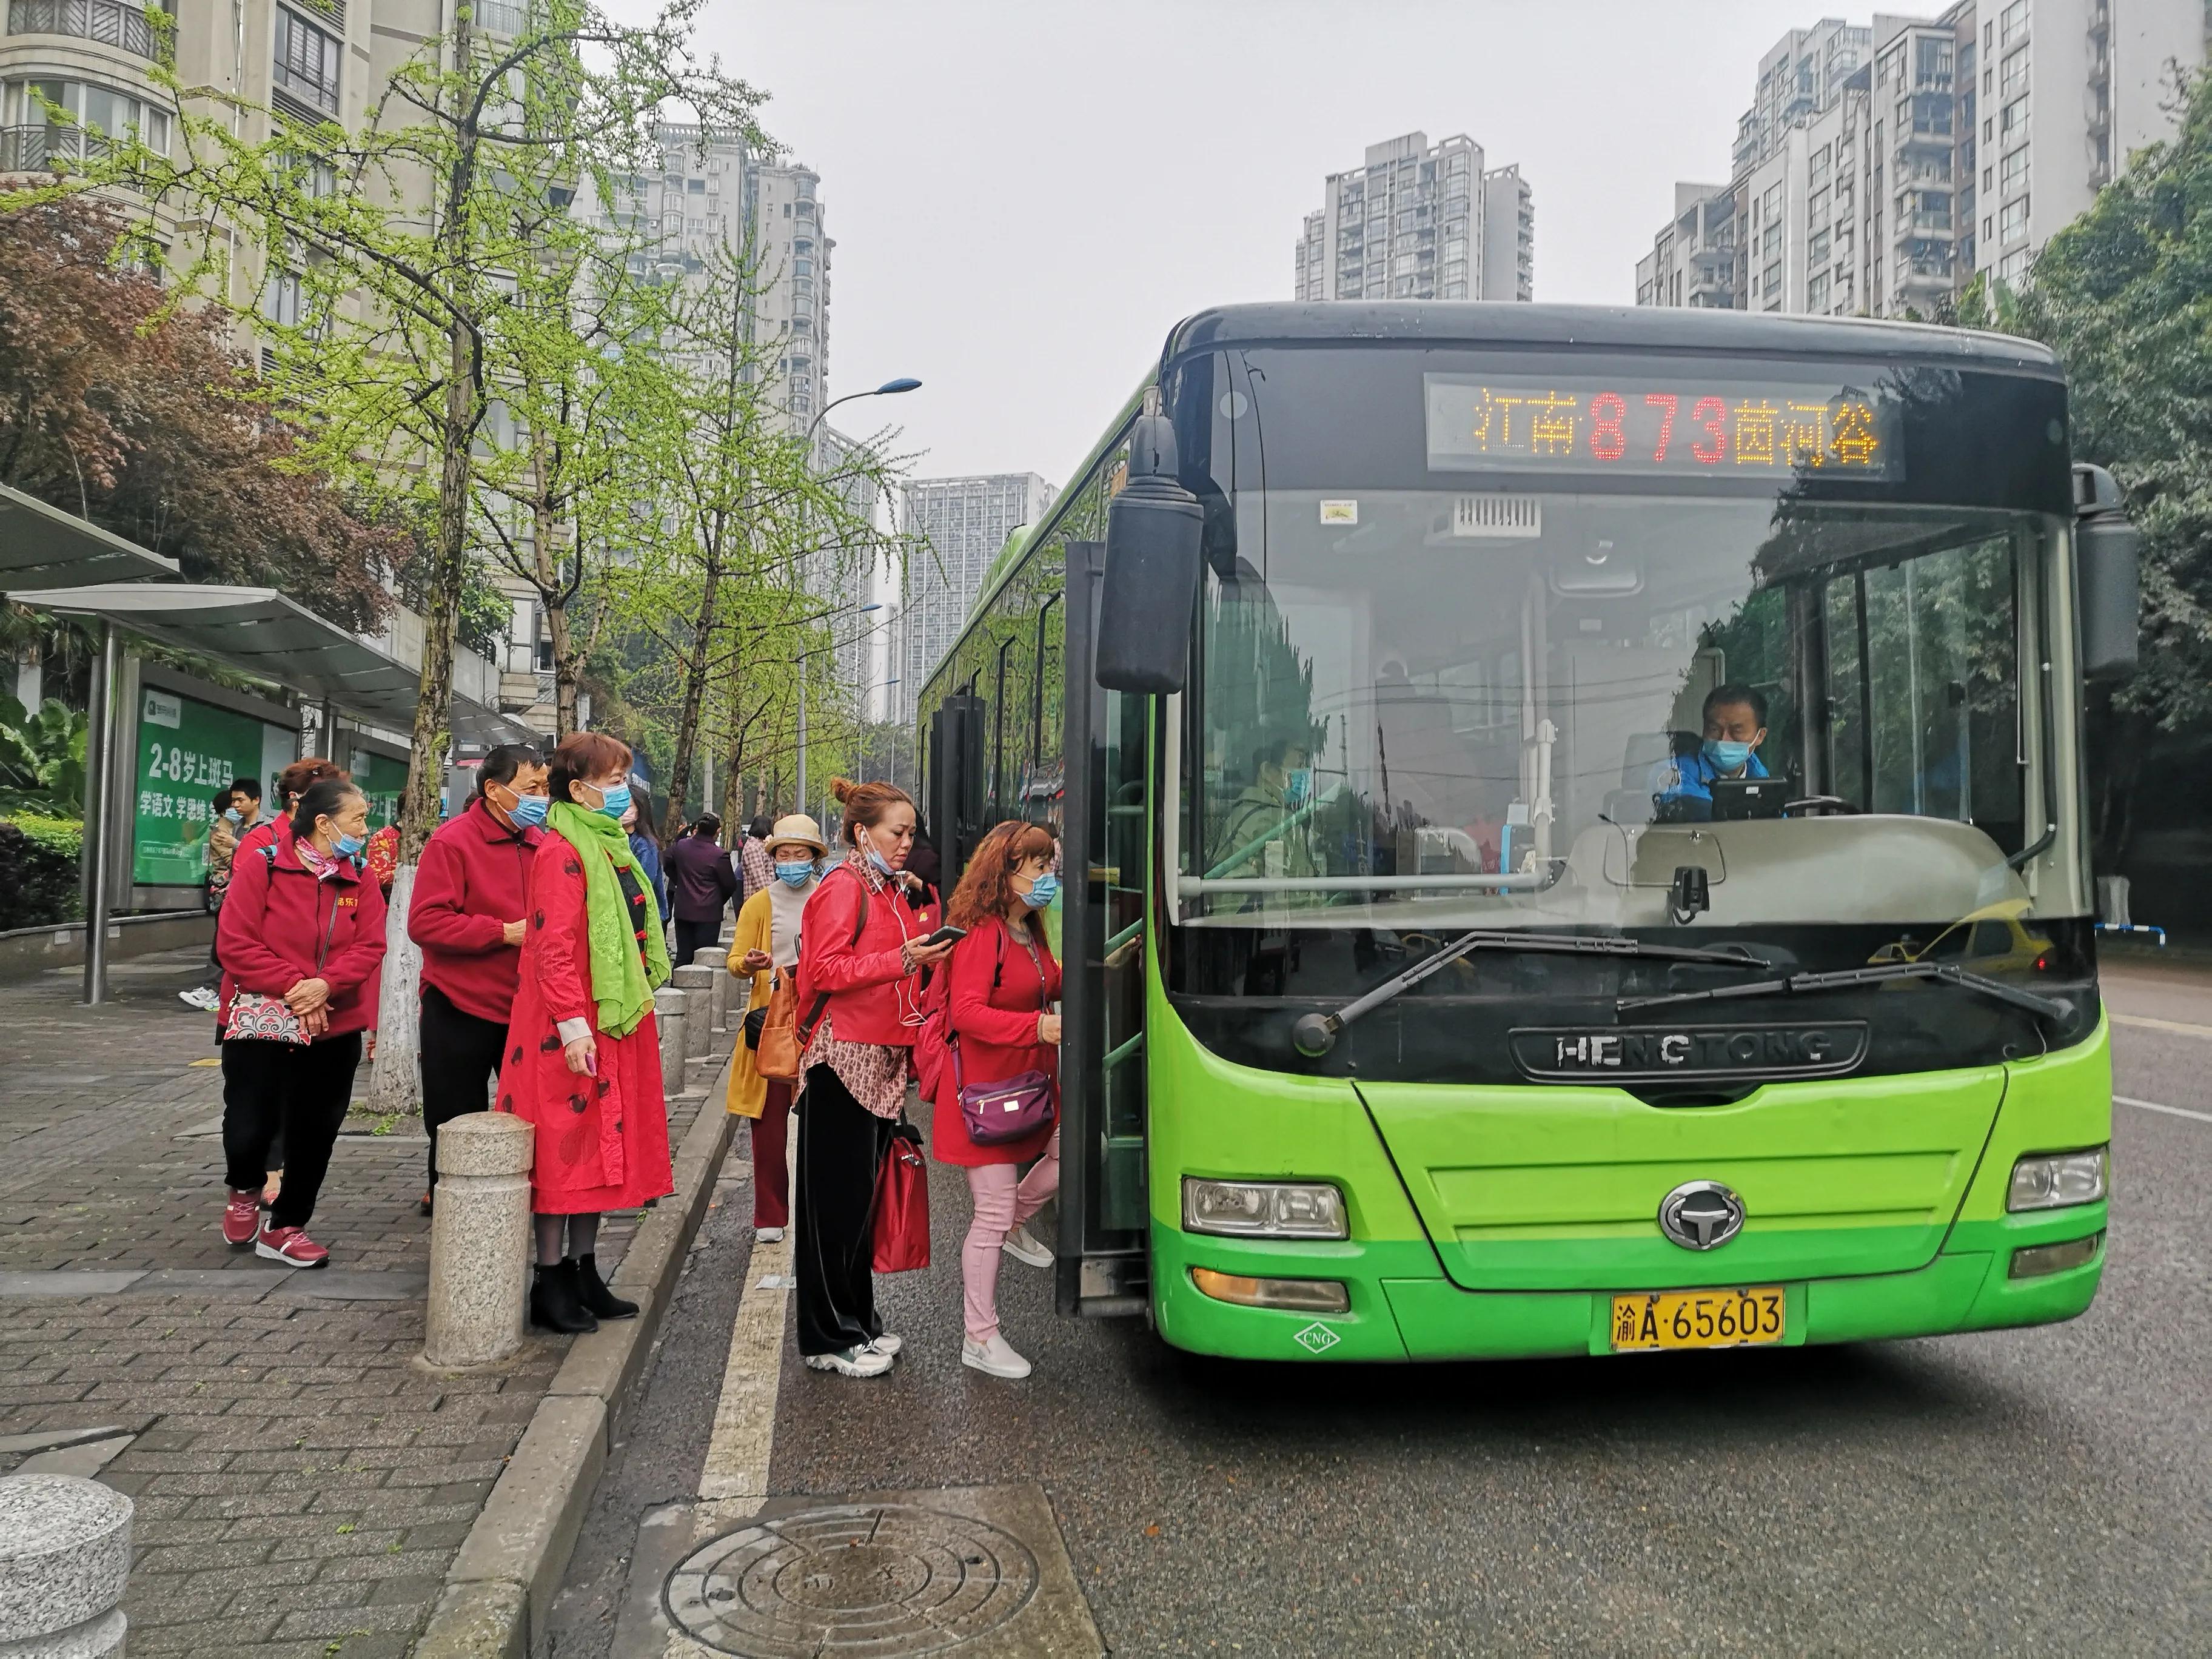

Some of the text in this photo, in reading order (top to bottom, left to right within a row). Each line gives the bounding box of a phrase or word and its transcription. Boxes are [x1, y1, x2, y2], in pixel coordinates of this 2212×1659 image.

[1474, 387, 1578, 454] 江南
[1590, 392, 1727, 464] 873
[140, 790, 173, 818] 学语文
[176, 796, 206, 822] 学思维
[1555, 1030, 1832, 1067] HENGTONG
[1304, 1332, 1330, 1345] CNG
